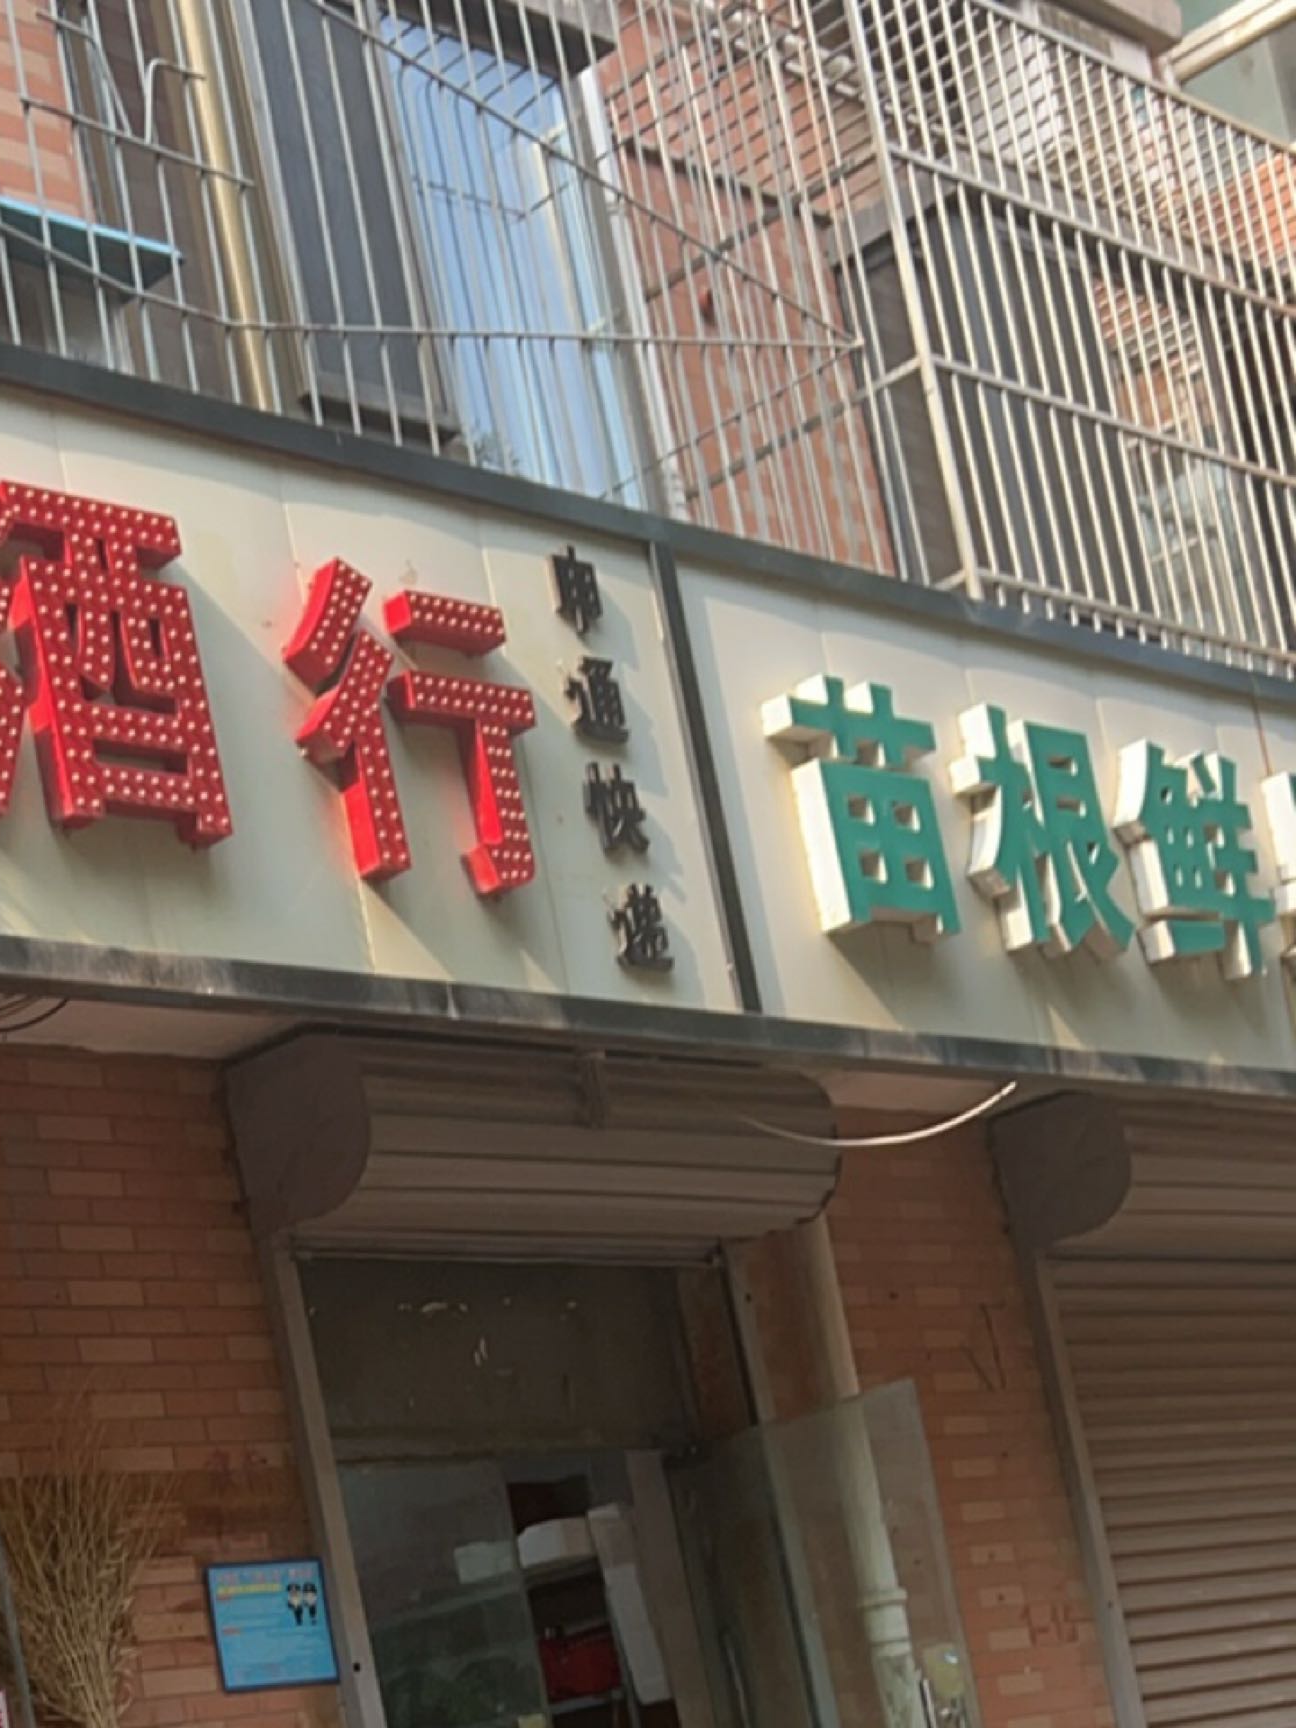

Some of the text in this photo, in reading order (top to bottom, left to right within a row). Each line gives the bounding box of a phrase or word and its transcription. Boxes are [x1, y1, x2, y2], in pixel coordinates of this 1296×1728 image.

[549, 545, 674, 970] 申通快递
[762, 674, 1296, 981] 苗根鲜
